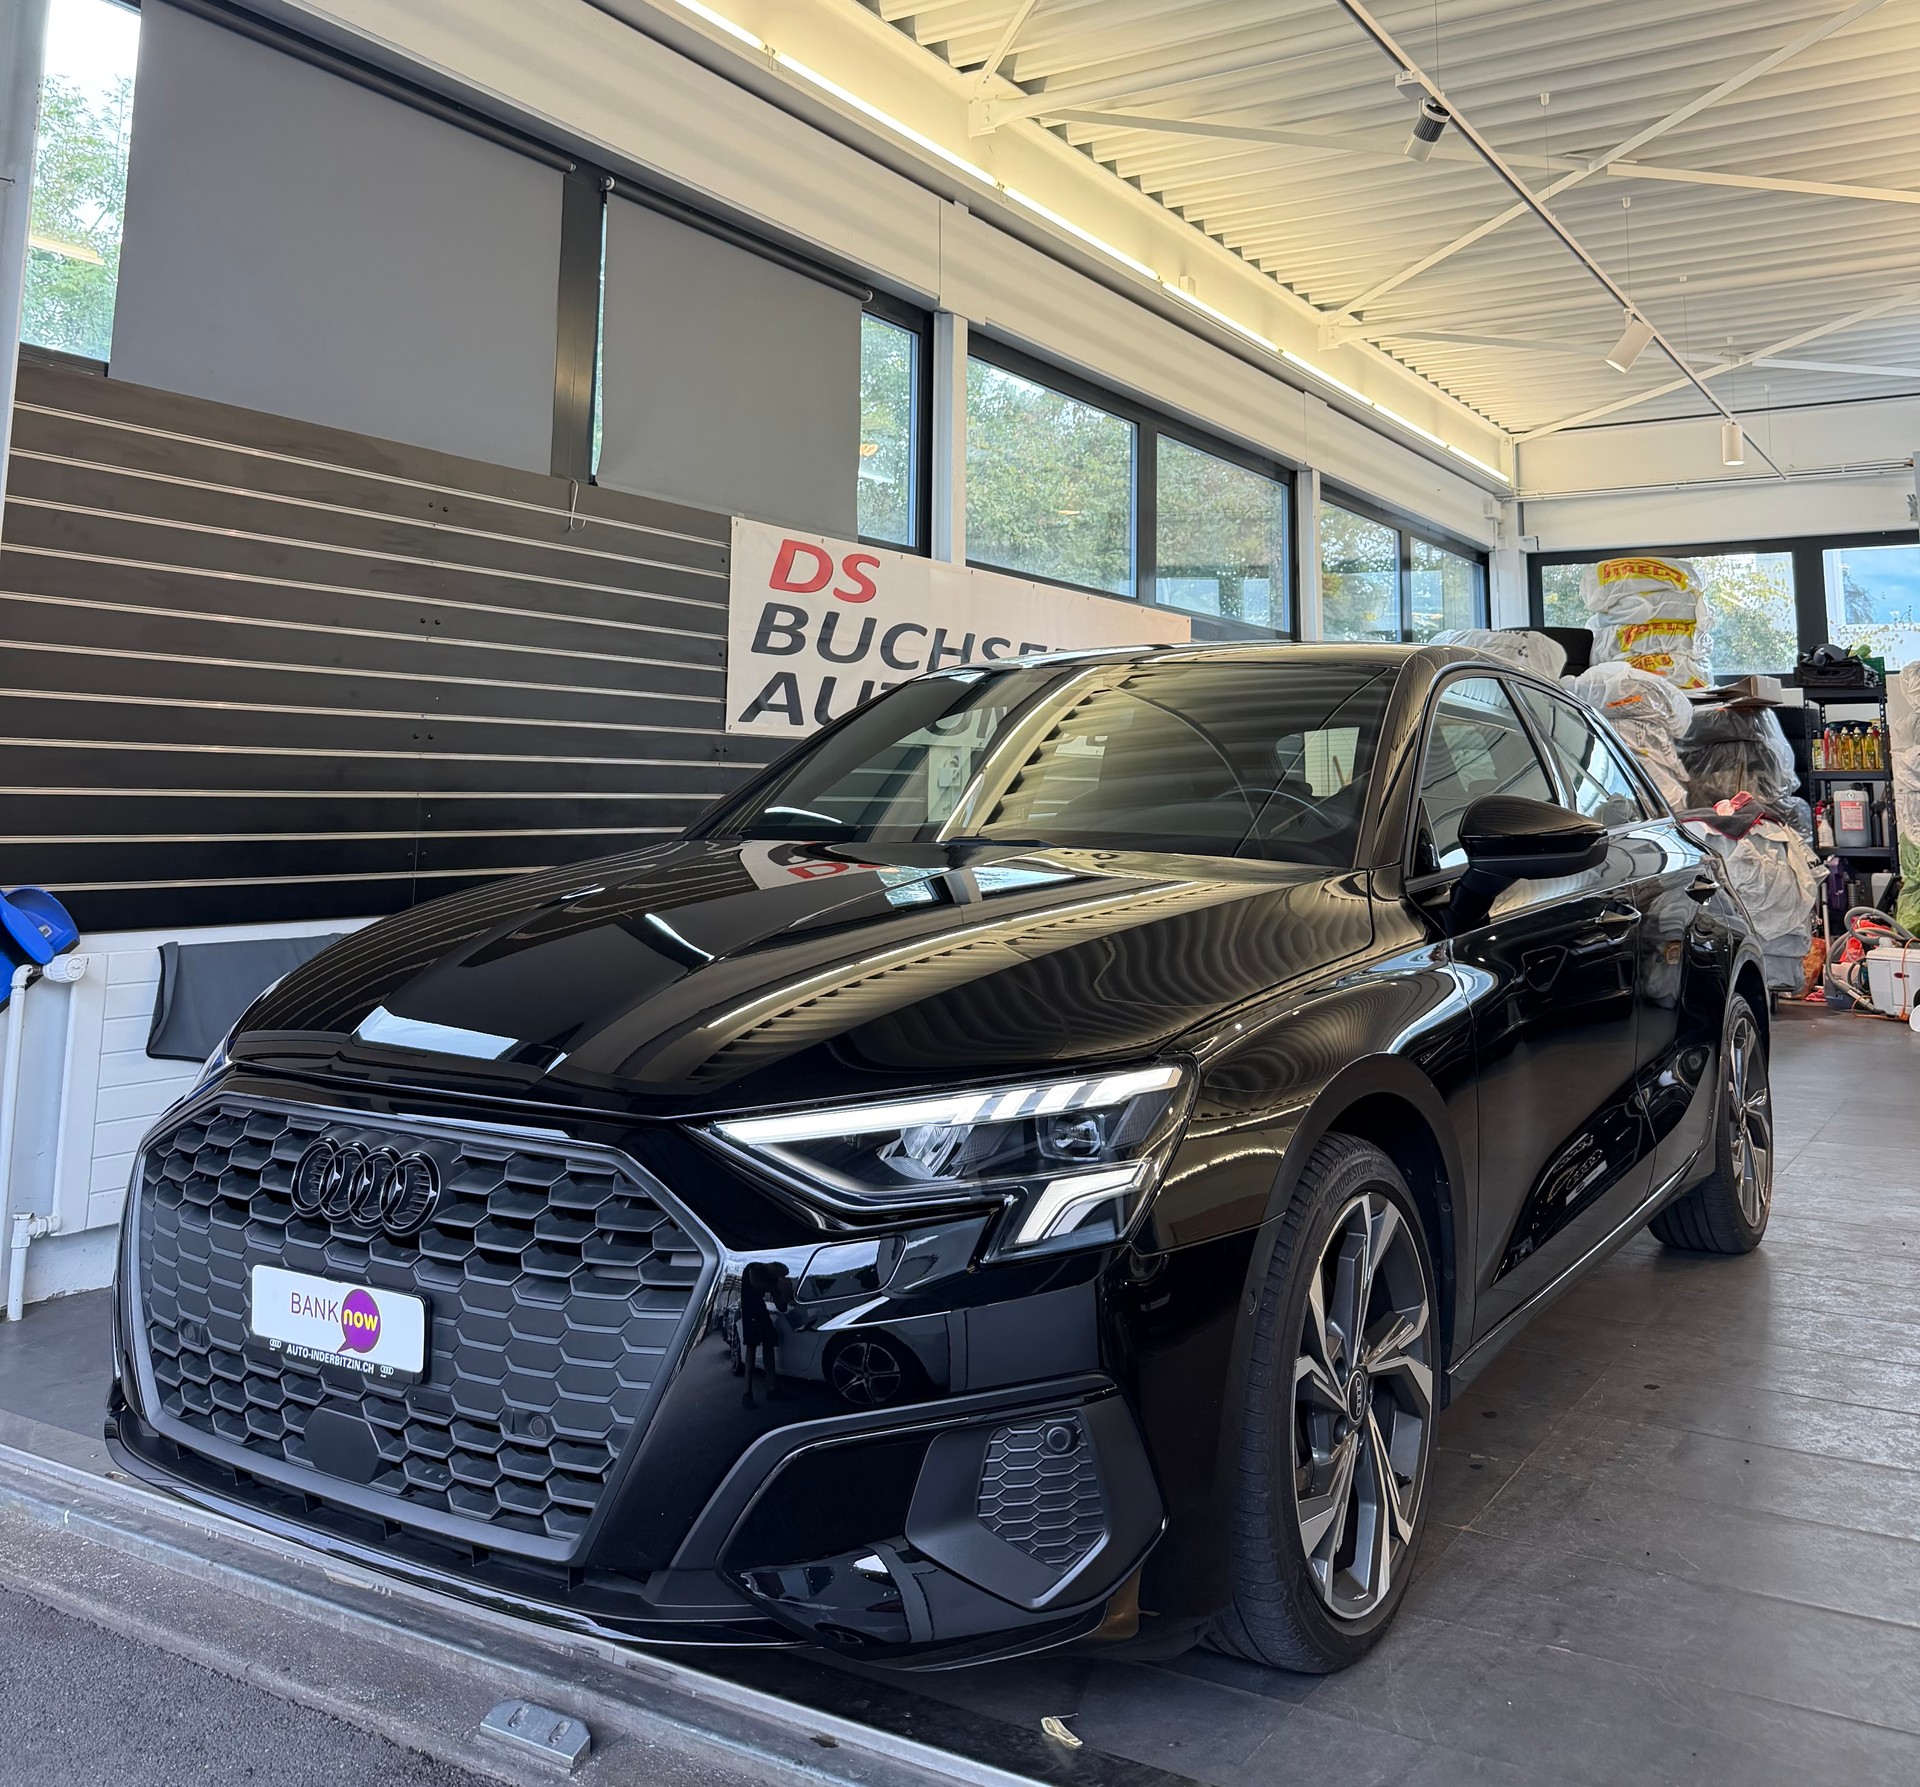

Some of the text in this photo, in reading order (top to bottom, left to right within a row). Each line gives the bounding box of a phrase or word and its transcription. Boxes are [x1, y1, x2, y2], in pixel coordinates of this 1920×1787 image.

[769, 538, 880, 603] DS
[751, 602, 1068, 671] BUCHS
[291, 1292, 379, 1331] BANK now
[286, 1344, 375, 1374] AUTO-INDERBITZIN.CH
